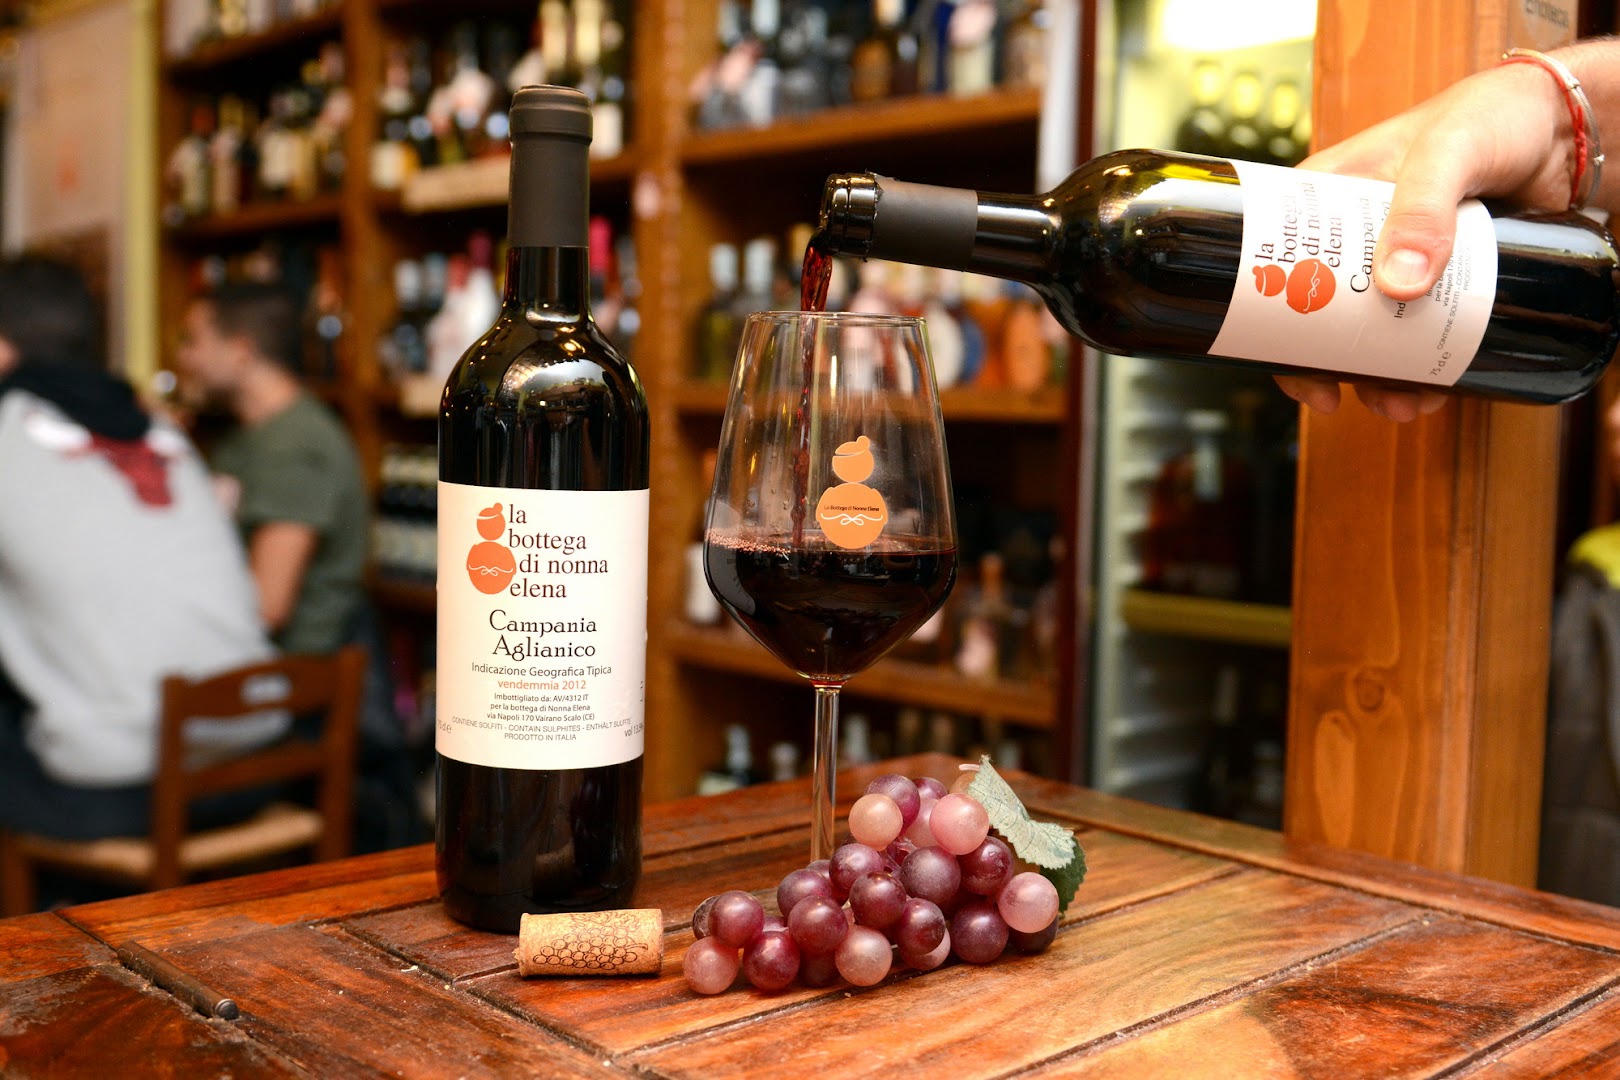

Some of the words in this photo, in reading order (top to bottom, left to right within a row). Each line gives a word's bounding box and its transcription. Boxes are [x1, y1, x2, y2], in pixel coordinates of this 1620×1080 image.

[1277, 195, 1302, 264] botteg
[1255, 242, 1275, 261] la
[1302, 236, 1320, 256] di
[1323, 216, 1342, 268] elena
[509, 504, 527, 524] la
[508, 528, 586, 555] bottega
[519, 554, 539, 573] di
[547, 559, 608, 574] nonna
[509, 578, 567, 598] elena
[489, 609, 597, 638] Campania
[492, 634, 596, 662] Aglianico
[471, 662, 527, 676] Indicazione
[529, 667, 585, 679] Geografica
[586, 665, 612, 677] Tipica
[497, 680, 560, 690] vendemmia
[562, 680, 586, 690] 2012
[494, 693, 540, 703] Imbottigliato
[497, 713, 520, 721] Napoli
[535, 714, 562, 722] Vairano
[563, 714, 582, 722] Scalo
[582, 713, 595, 721] (CE)
[510, 704, 538, 713] bottega
[452, 716, 478, 727] CONTIENE
[478, 721, 503, 730] SOLFITI
[508, 724, 541, 732] CONTAIN
[542, 724, 581, 732] SULPHITES
[504, 732, 544, 741] PRODOTTO
[555, 733, 577, 741] ITALIA
